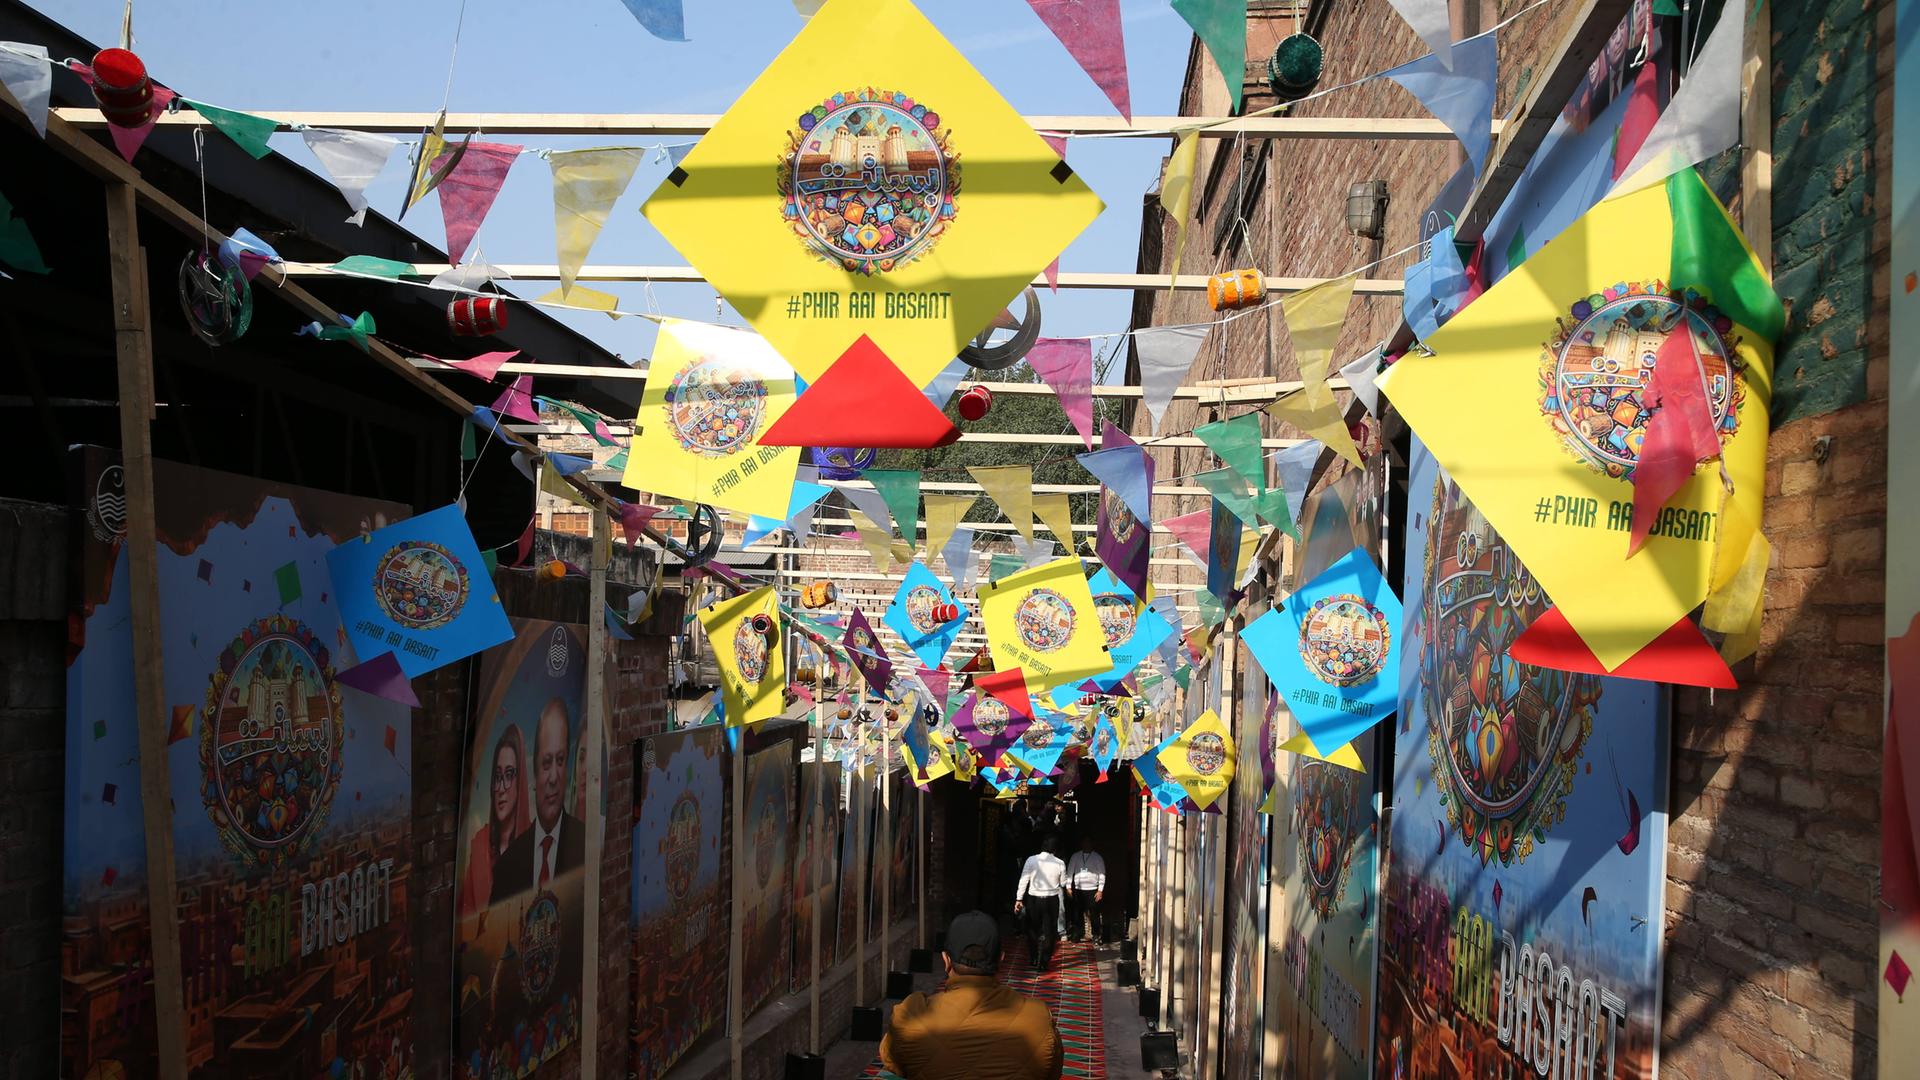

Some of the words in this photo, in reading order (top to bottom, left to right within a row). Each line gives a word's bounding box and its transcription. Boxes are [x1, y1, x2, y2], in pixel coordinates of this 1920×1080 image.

[786, 292, 839, 319] #PHIR
[849, 292, 875, 319] AAI
[885, 292, 951, 319] BASANT
[712, 469, 741, 498] #PHIR
[740, 455, 759, 478] AAI
[757, 445, 790, 465] BASA
[1534, 495, 1598, 528] #PHIR
[1607, 500, 1634, 532] AA
[355, 621, 385, 640] #PHIR
[385, 631, 402, 648] AAI
[403, 638, 440, 661] BASANT
[1000, 642, 1018, 658] #PHIR
[1018, 652, 1030, 664] AAI
[1029, 657, 1052, 677] BASANT
[1292, 688, 1320, 706] #PHIR
[1322, 693, 1337, 709] AAI
[1340, 697, 1375, 718] BASANT
[243, 891, 292, 980] AAI
[300, 857, 394, 958] BASANT
[1453, 905, 1493, 1030] AAI
[1498, 928, 1627, 1080] BASANT
